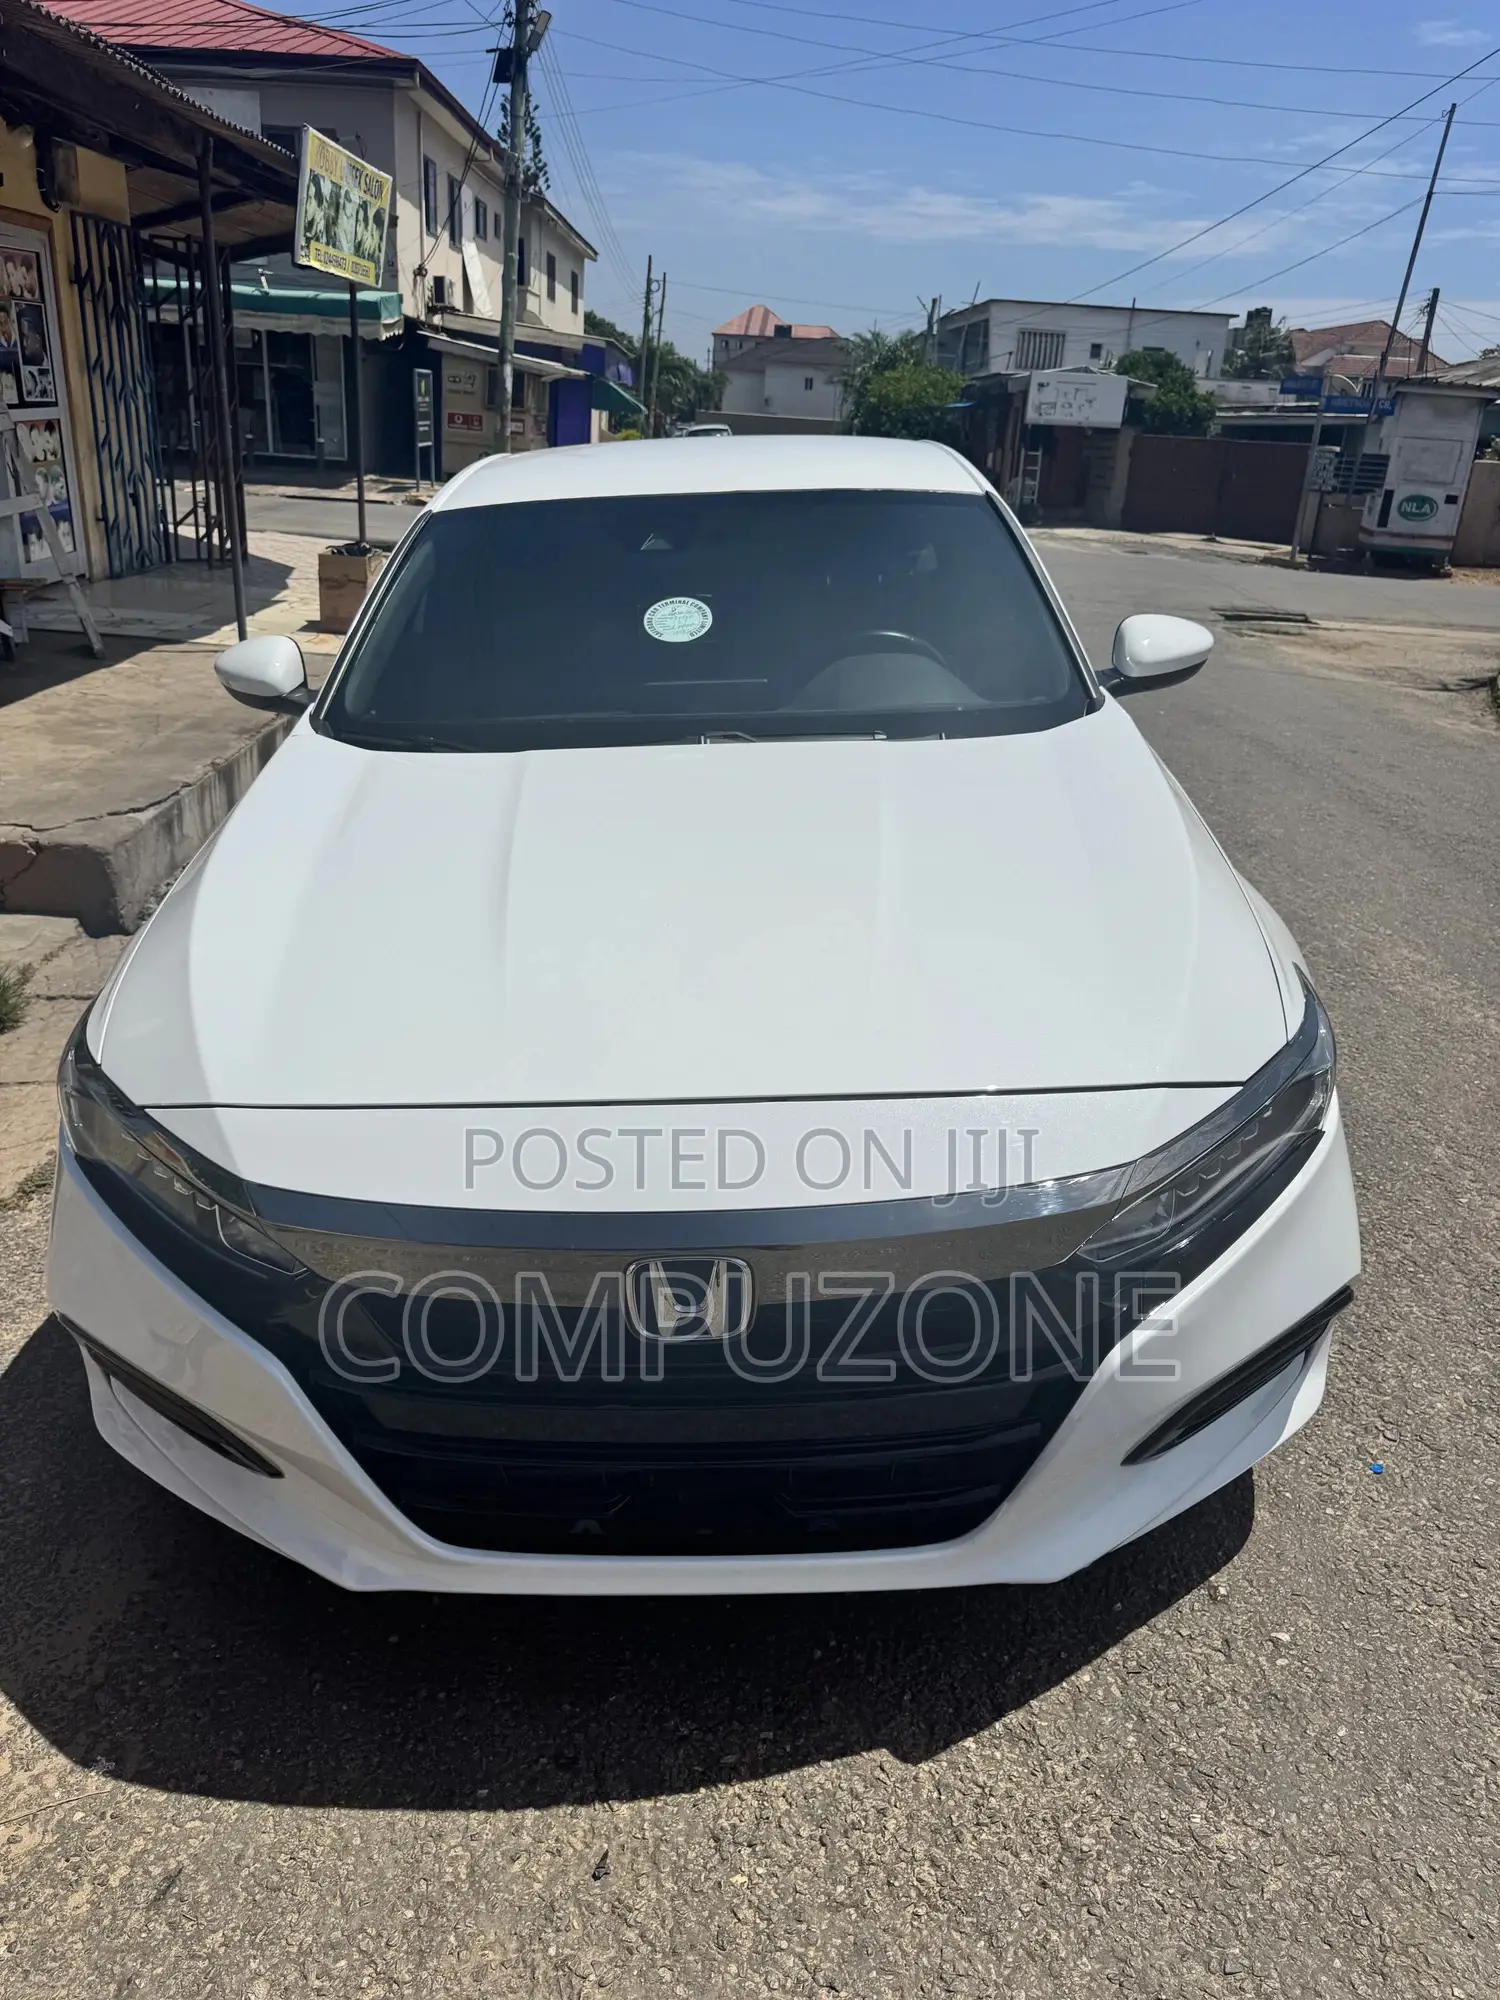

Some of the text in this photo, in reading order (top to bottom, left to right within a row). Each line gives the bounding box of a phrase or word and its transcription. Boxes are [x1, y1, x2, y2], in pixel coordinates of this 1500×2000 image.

[363, 172, 383, 202] SALON
[1401, 502, 1431, 514] NLA
[649, 606, 660, 617] CAR
[657, 599, 690, 609] TERMINAL
[690, 602, 708, 621] COMPANY
[689, 620, 708, 638] LIMITED
